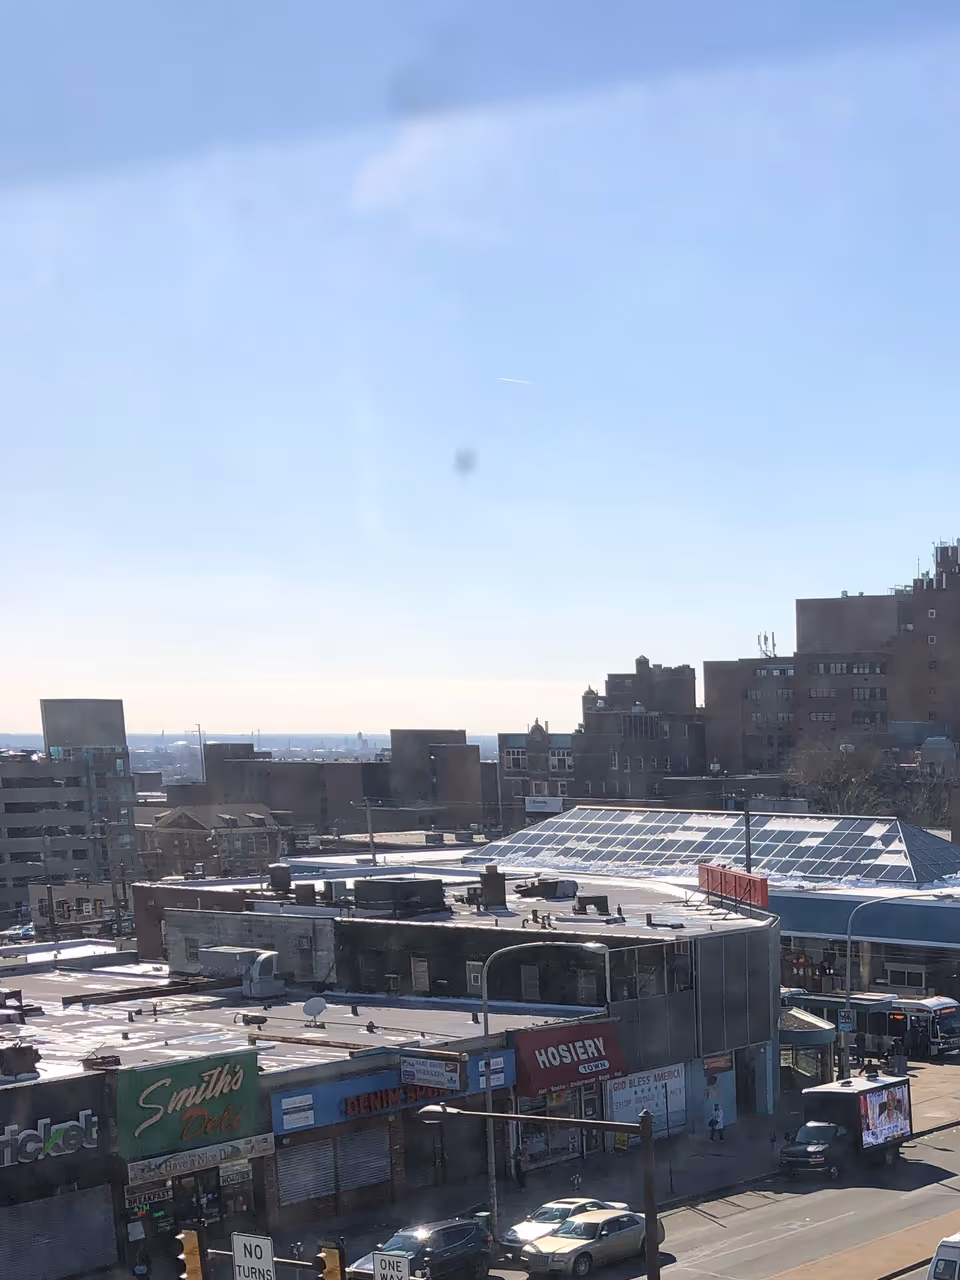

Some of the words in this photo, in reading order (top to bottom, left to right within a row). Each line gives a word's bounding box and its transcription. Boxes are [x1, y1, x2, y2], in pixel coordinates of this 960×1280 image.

[535, 1037, 606, 1069] HOSIERY
[582, 1061, 606, 1073] TOWN
[613, 1081, 627, 1093] GOD
[629, 1075, 651, 1089] BLESS
[135, 1063, 244, 1138] Smith's
[0, 1109, 98, 1168] icket
[127, 1190, 171, 1208] BREAKFAST
[243, 1242, 263, 1261] NO
[380, 1258, 403, 1273] ONE
